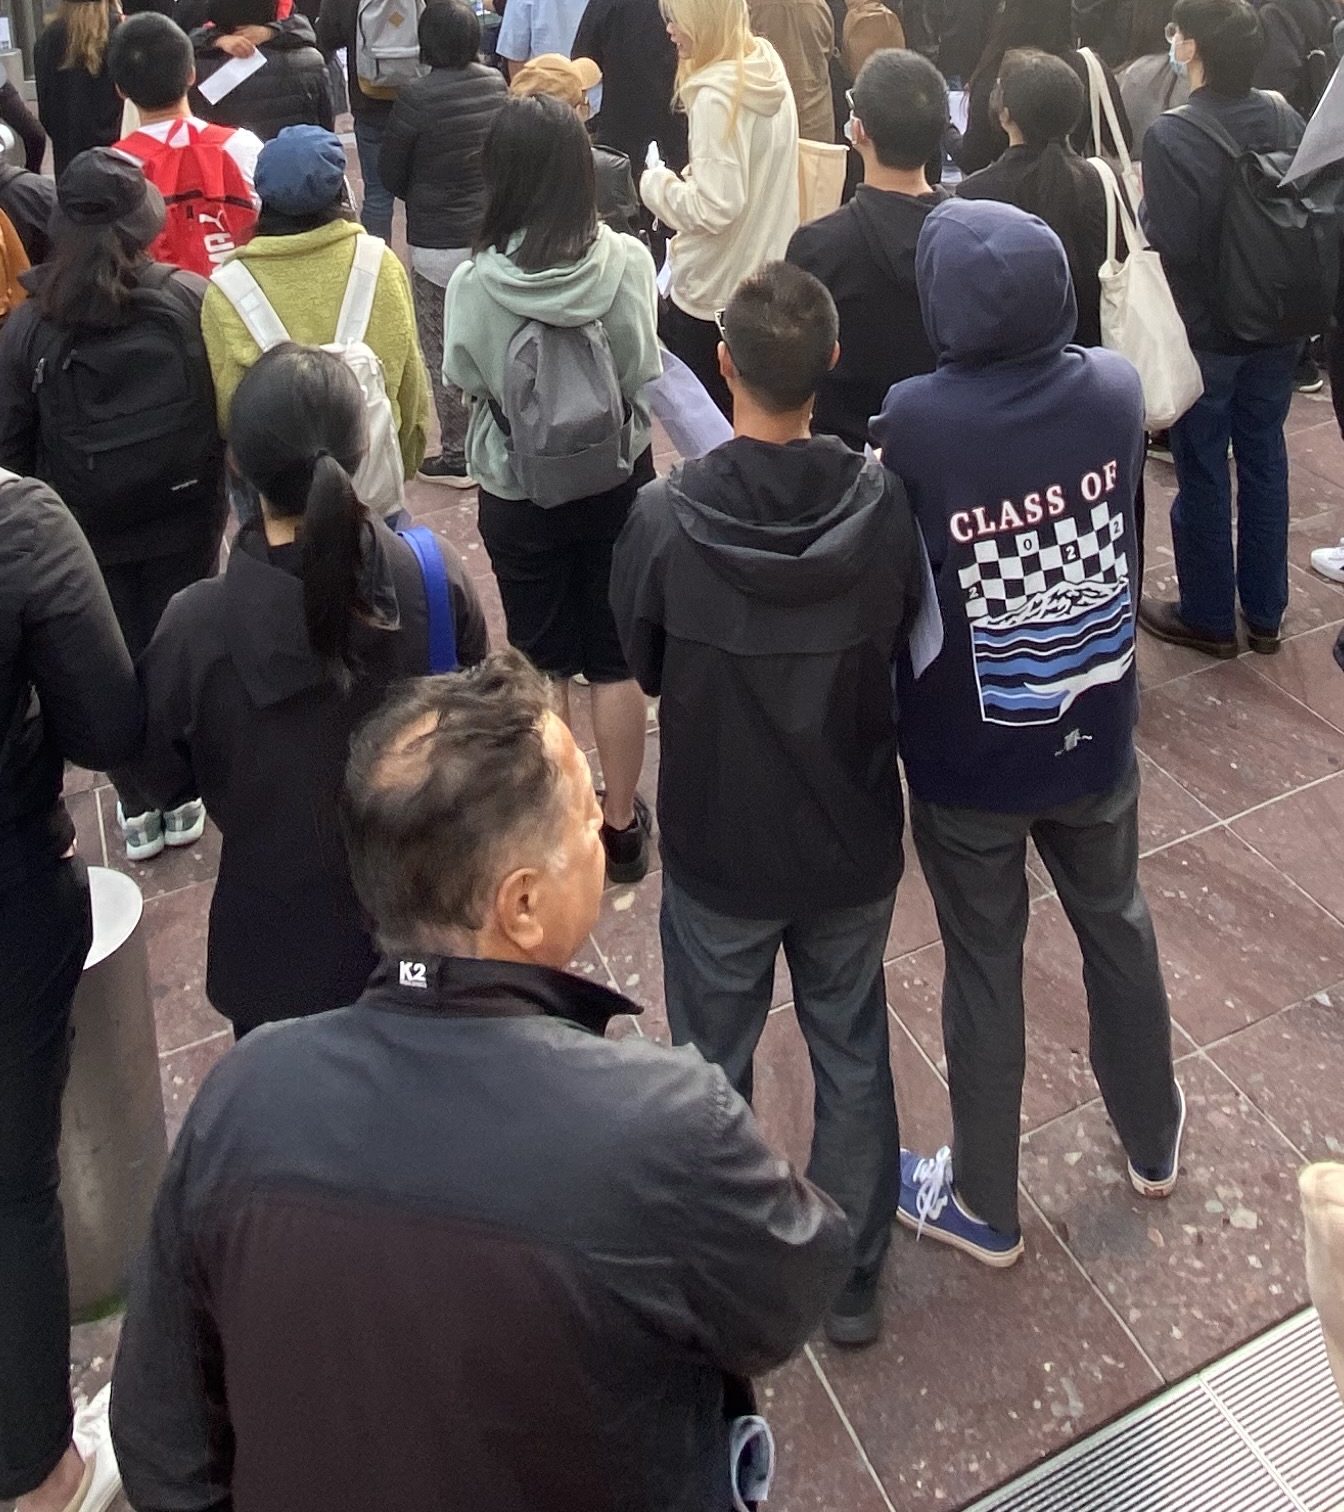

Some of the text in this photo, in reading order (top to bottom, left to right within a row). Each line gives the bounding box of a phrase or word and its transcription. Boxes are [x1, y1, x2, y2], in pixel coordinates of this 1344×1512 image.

[949, 459, 1119, 544] CLASS OF
[1065, 544, 1076, 560] 2
[399, 960, 427, 981] K2
